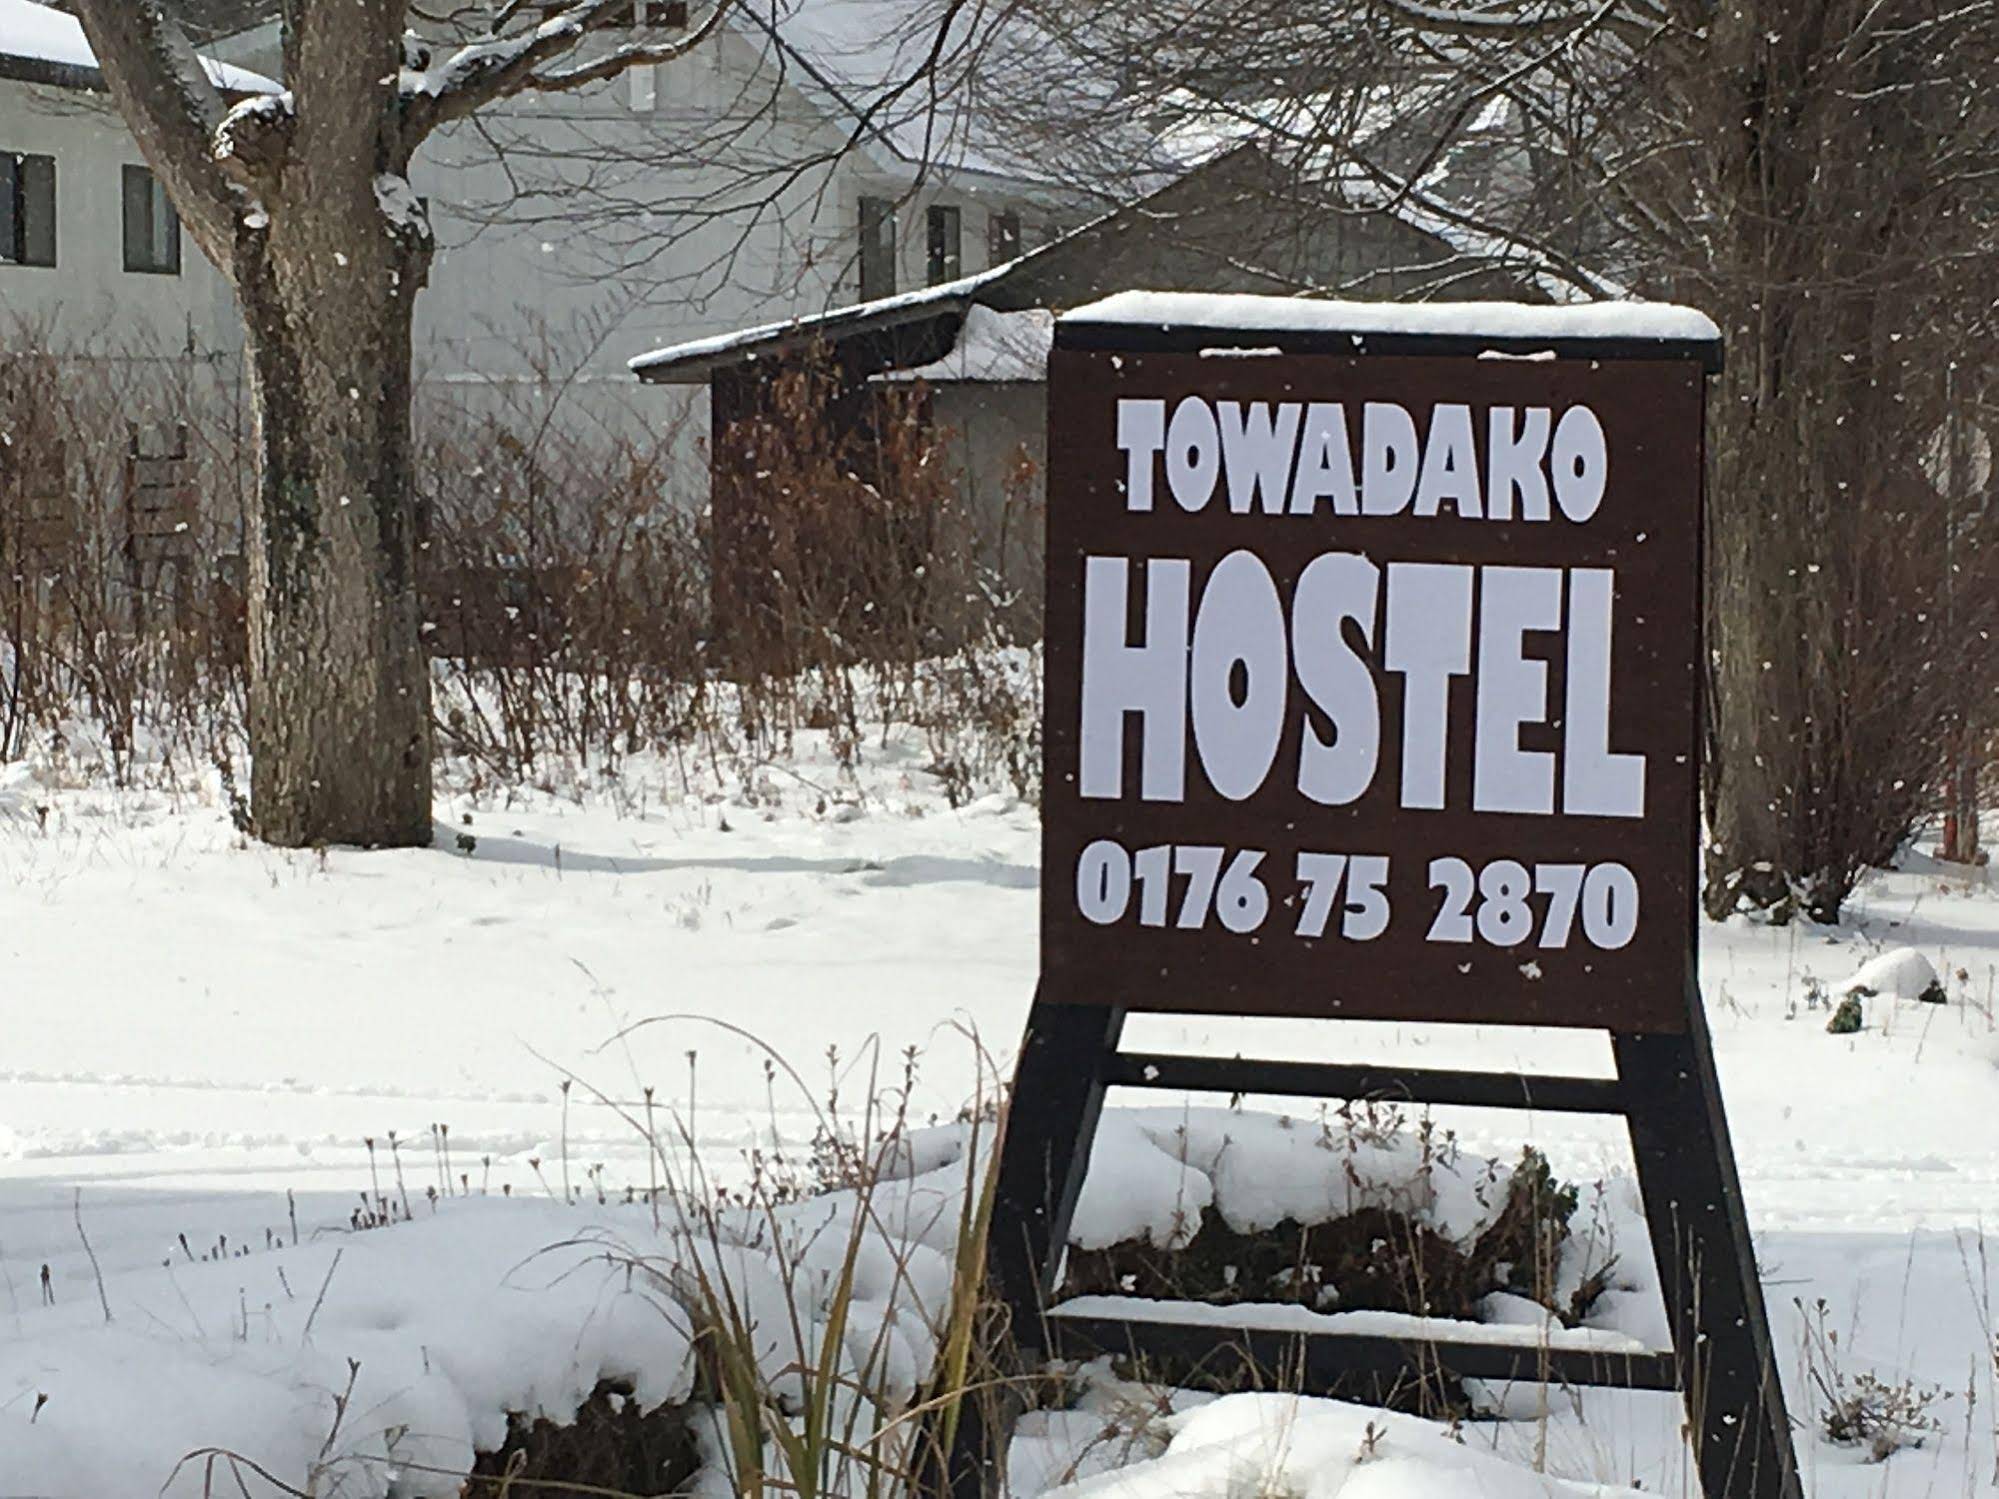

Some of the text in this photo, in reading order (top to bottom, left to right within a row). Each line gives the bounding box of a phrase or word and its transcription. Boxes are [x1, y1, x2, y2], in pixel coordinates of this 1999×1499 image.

[1117, 396, 1608, 523] TOWADAKO
[1079, 549, 1646, 818] HOSTEL
[1077, 840, 1639, 950] 0176 75 2870
